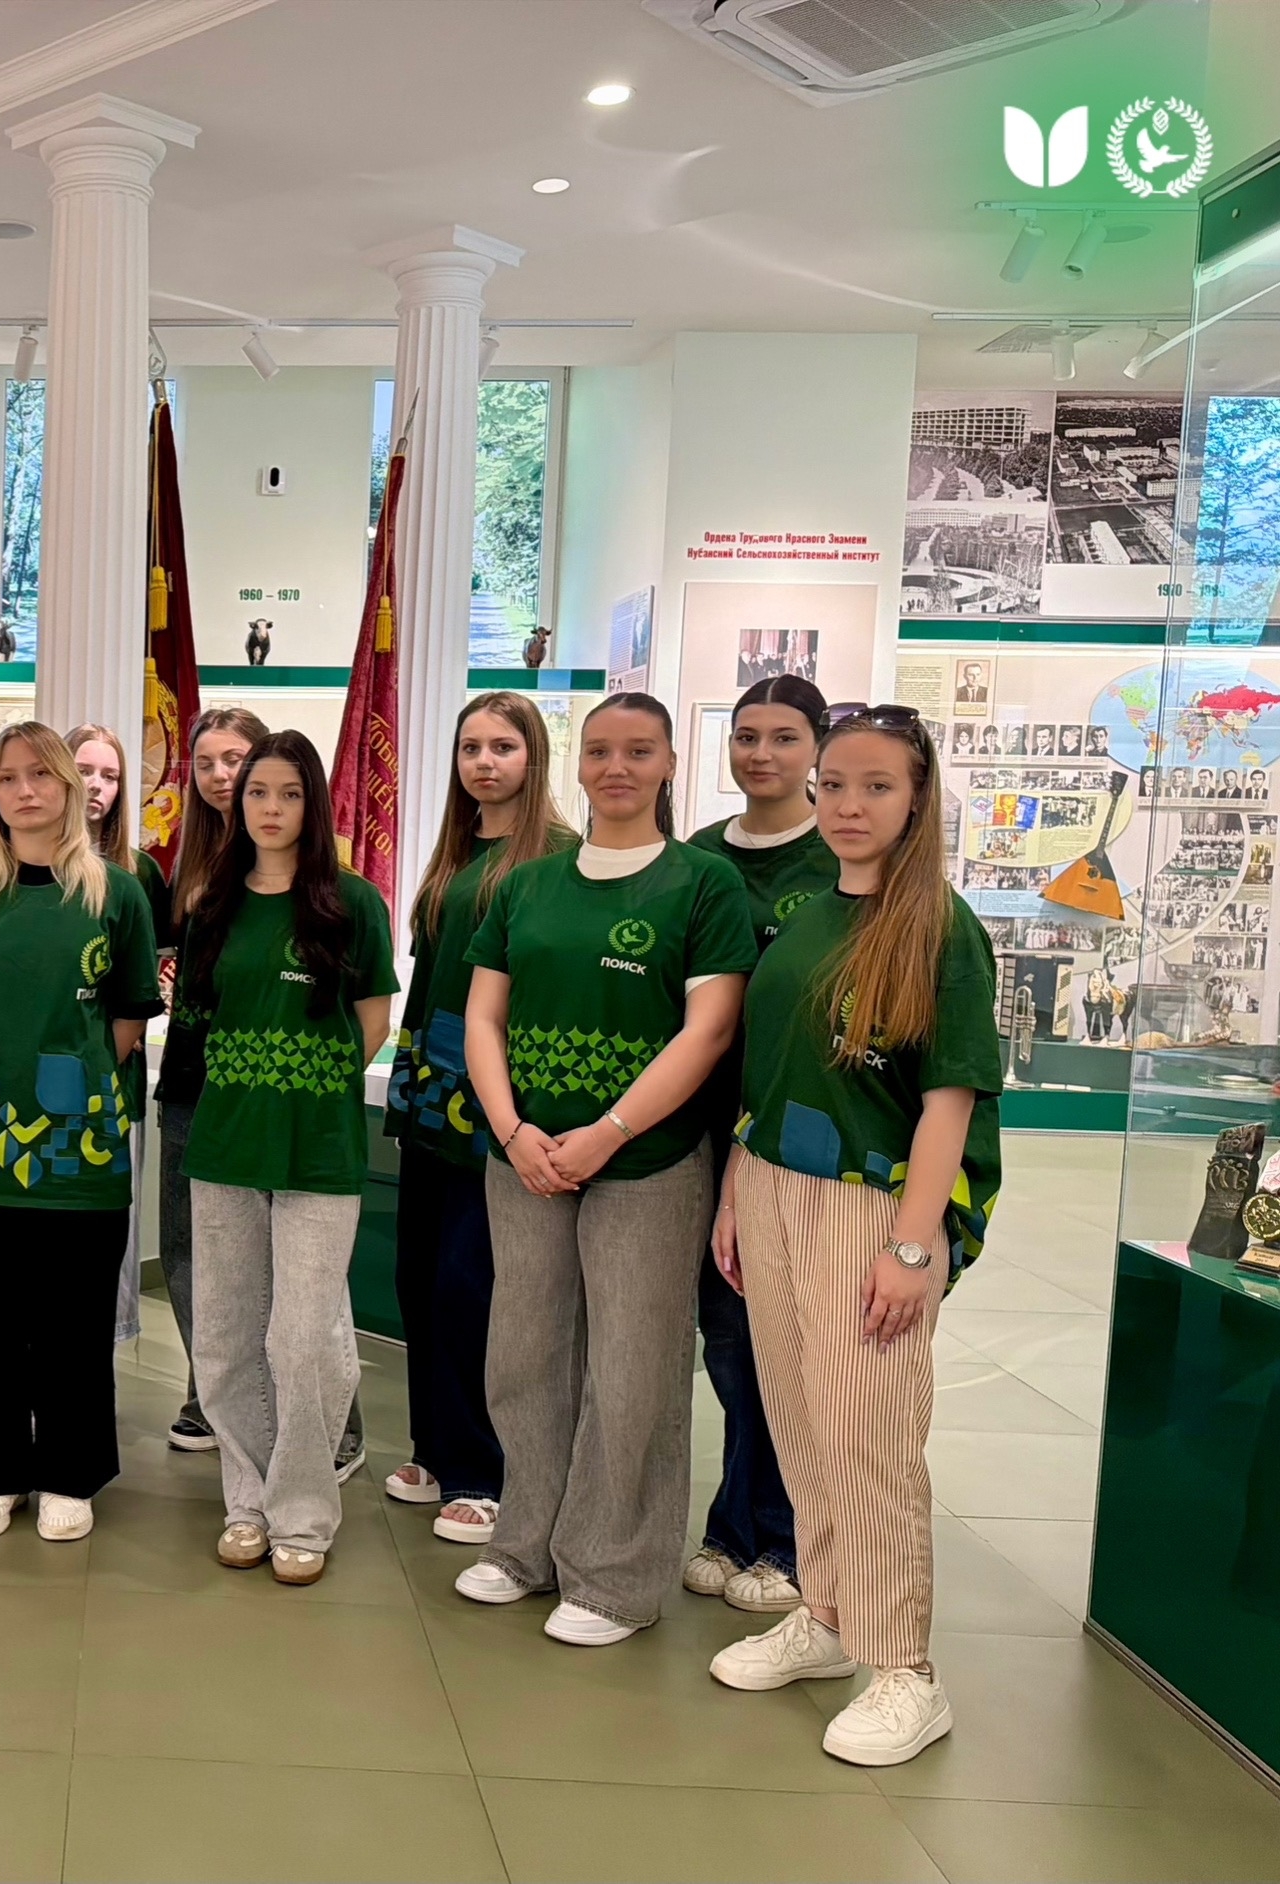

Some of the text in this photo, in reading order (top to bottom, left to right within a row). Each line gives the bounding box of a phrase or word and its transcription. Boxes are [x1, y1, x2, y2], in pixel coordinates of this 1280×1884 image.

[704, 531, 736, 545] Ордена
[785, 533, 825, 545] Красного
[828, 533, 867, 545] Знамени
[736, 548, 839, 560] Сельскохозяйственный
[842, 551, 880, 562] институт
[239, 588, 263, 601] 1960
[277, 588, 300, 601] 1970
[600, 956, 647, 976] ПОИСК
[280, 971, 317, 985] ПОИСК
